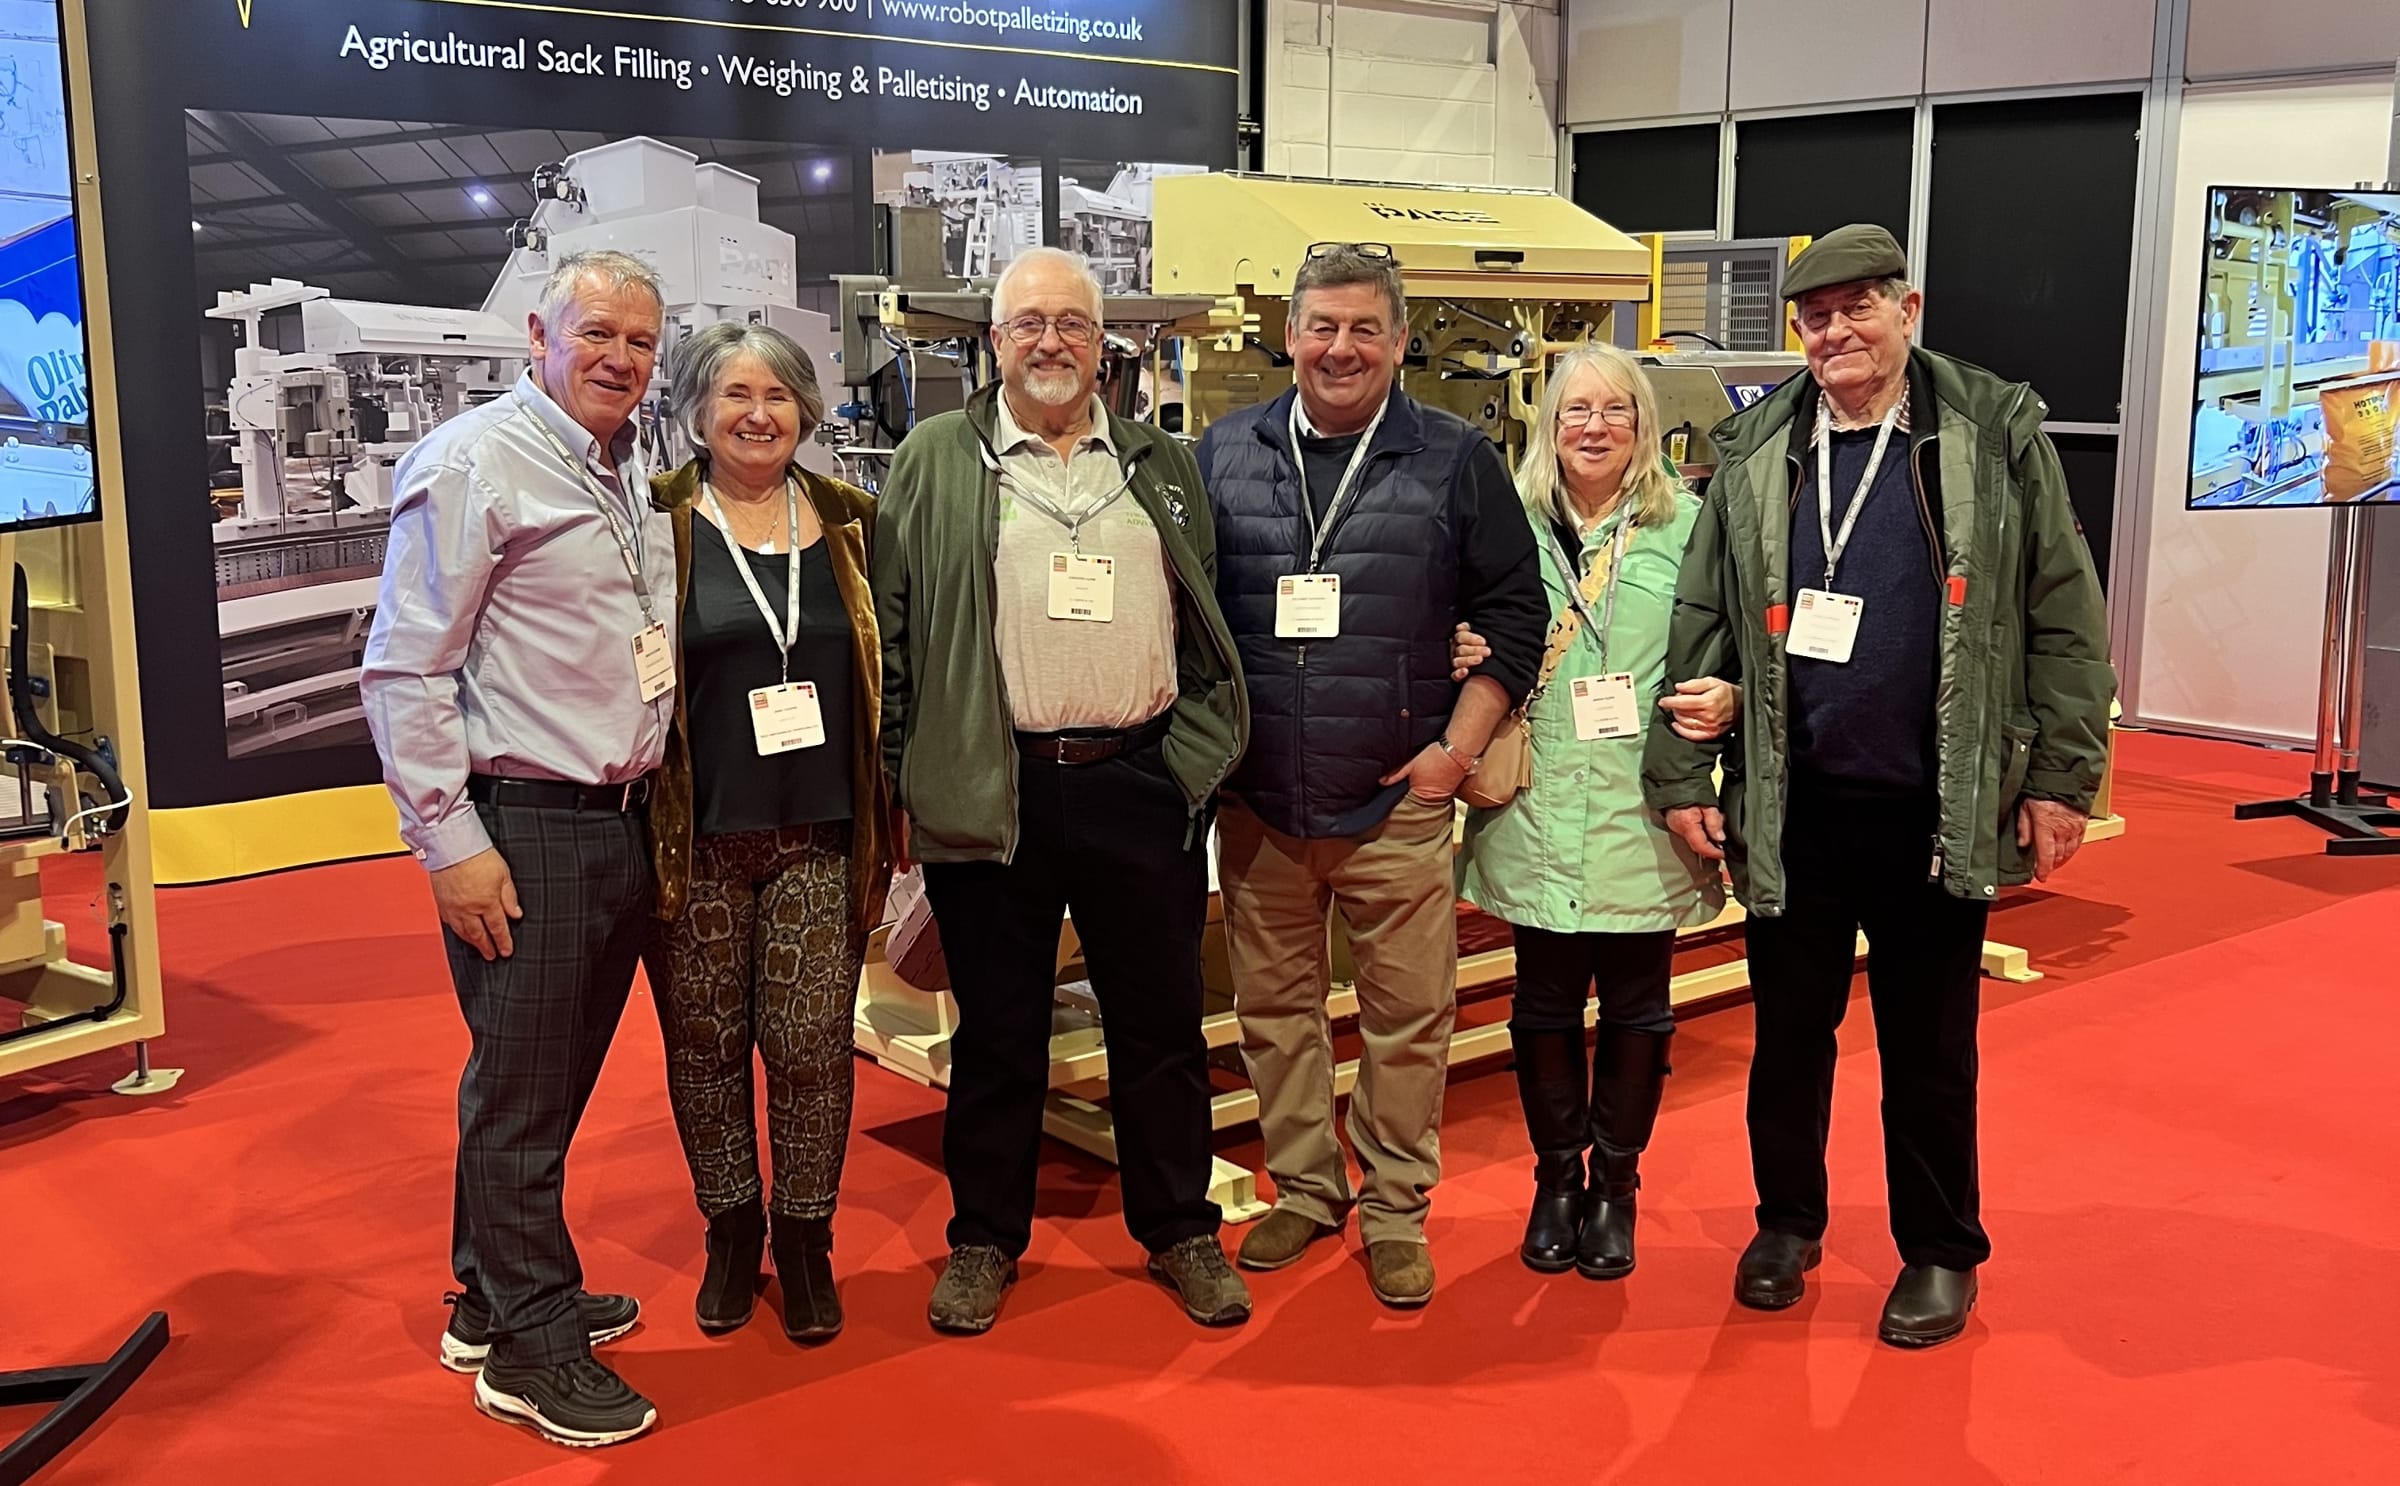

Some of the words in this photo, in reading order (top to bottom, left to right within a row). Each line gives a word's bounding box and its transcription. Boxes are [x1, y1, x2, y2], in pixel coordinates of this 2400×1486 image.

[881, 0, 1143, 43] www.robotpalletizing.co.uk
[339, 24, 526, 70] Agricultural
[536, 39, 605, 76] Sack
[613, 45, 693, 90] Filling
[717, 54, 843, 100] Weighing
[849, 65, 870, 95] &
[878, 66, 991, 112] Palletising
[1013, 77, 1143, 115] Automation
[1368, 206, 1500, 223] PACE
